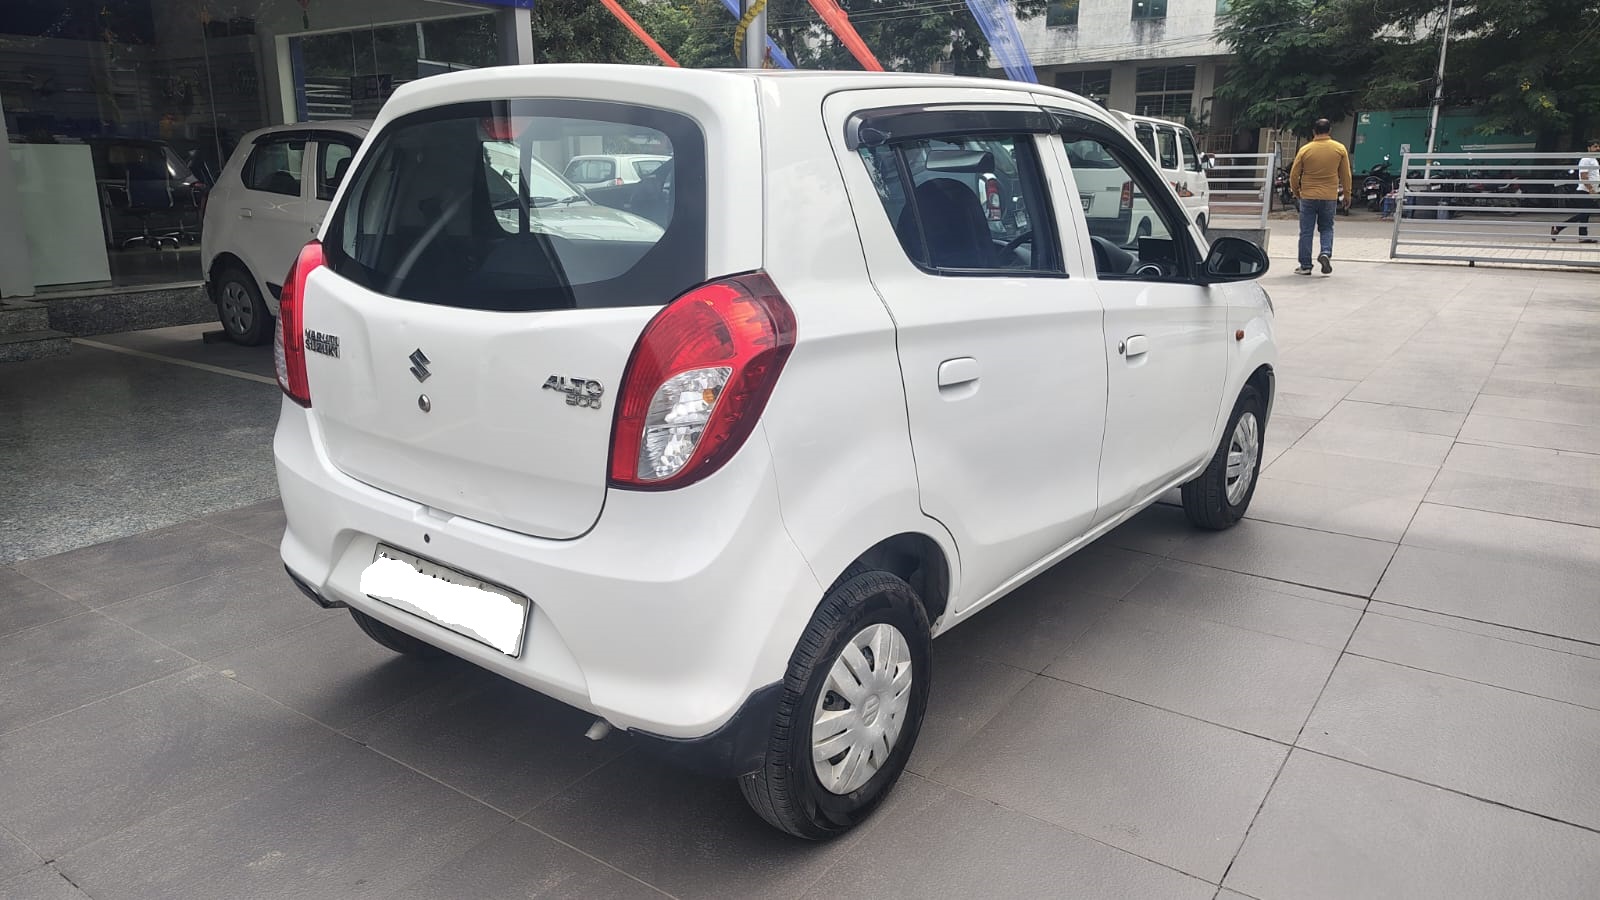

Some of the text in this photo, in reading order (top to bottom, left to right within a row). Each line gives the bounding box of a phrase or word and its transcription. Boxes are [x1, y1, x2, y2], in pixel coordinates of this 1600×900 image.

[305, 329, 339, 346] MARUTI
[305, 339, 340, 358] SUZUKI
[541, 375, 604, 398] ALTO
